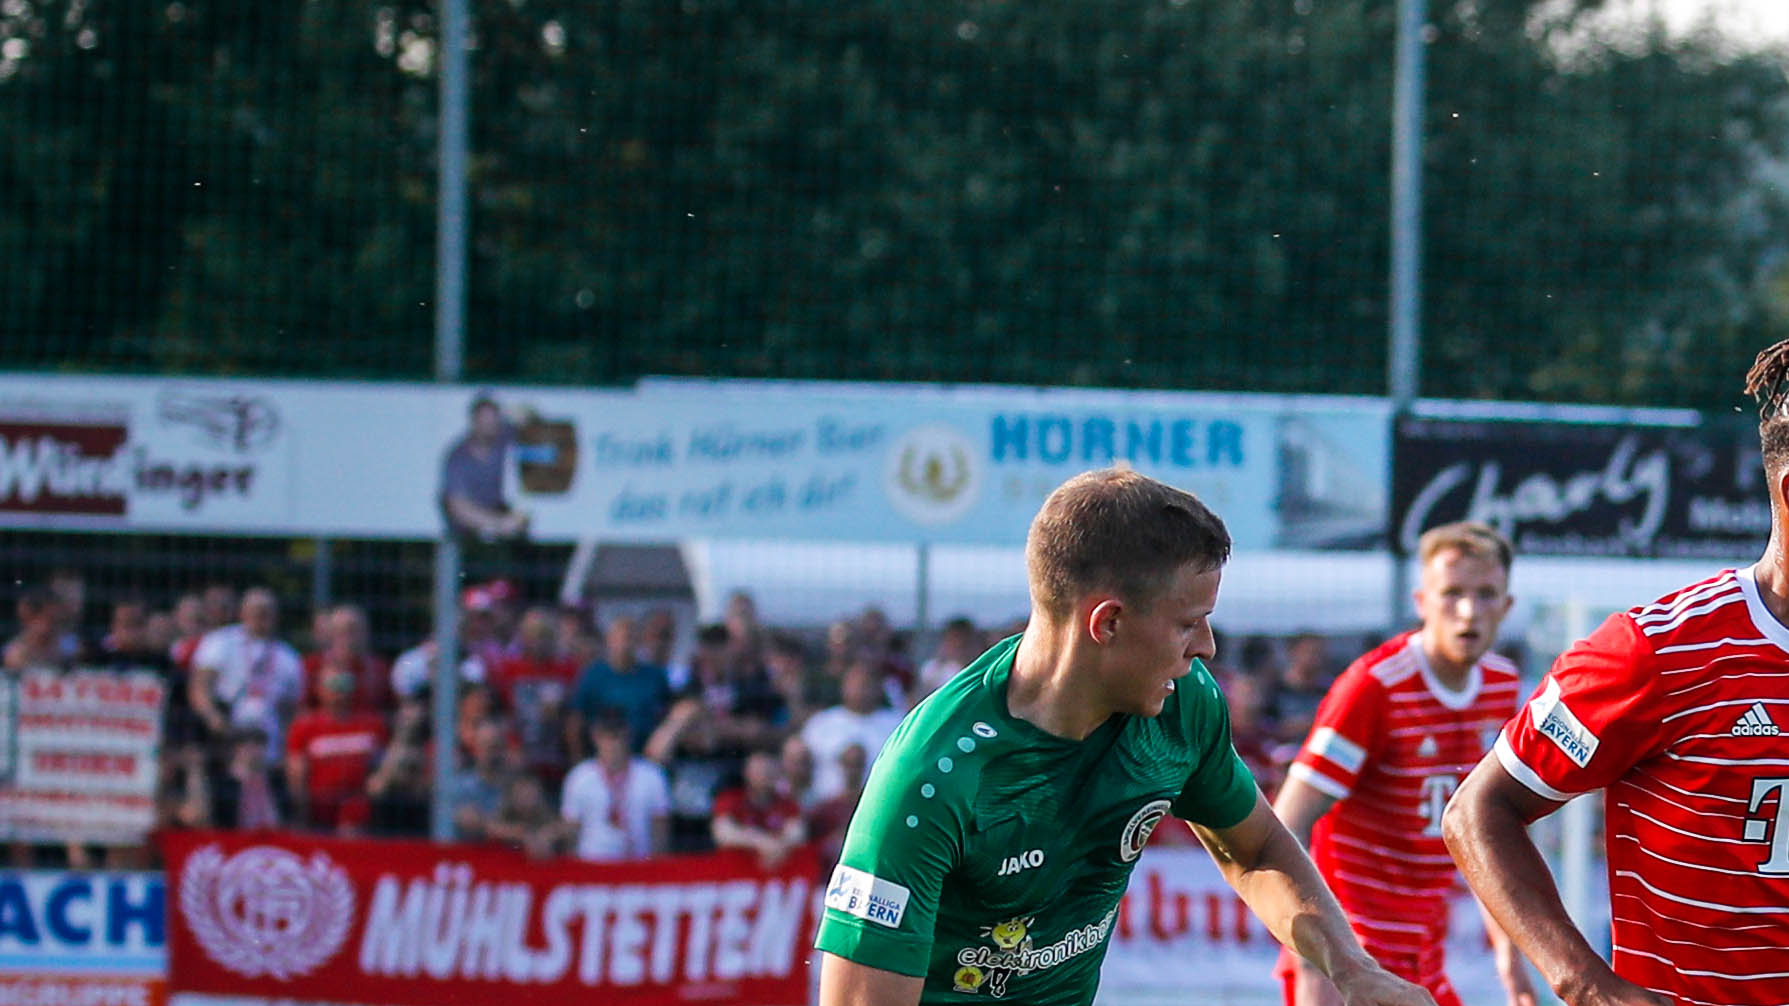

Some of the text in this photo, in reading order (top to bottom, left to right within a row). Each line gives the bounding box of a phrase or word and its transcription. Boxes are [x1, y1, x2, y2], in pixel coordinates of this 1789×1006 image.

[1731, 723, 1780, 736] adidas
[997, 849, 1045, 876] JAKO
[0, 878, 166, 945] ACH
[359, 863, 808, 986] MÜHLSTETTEN
